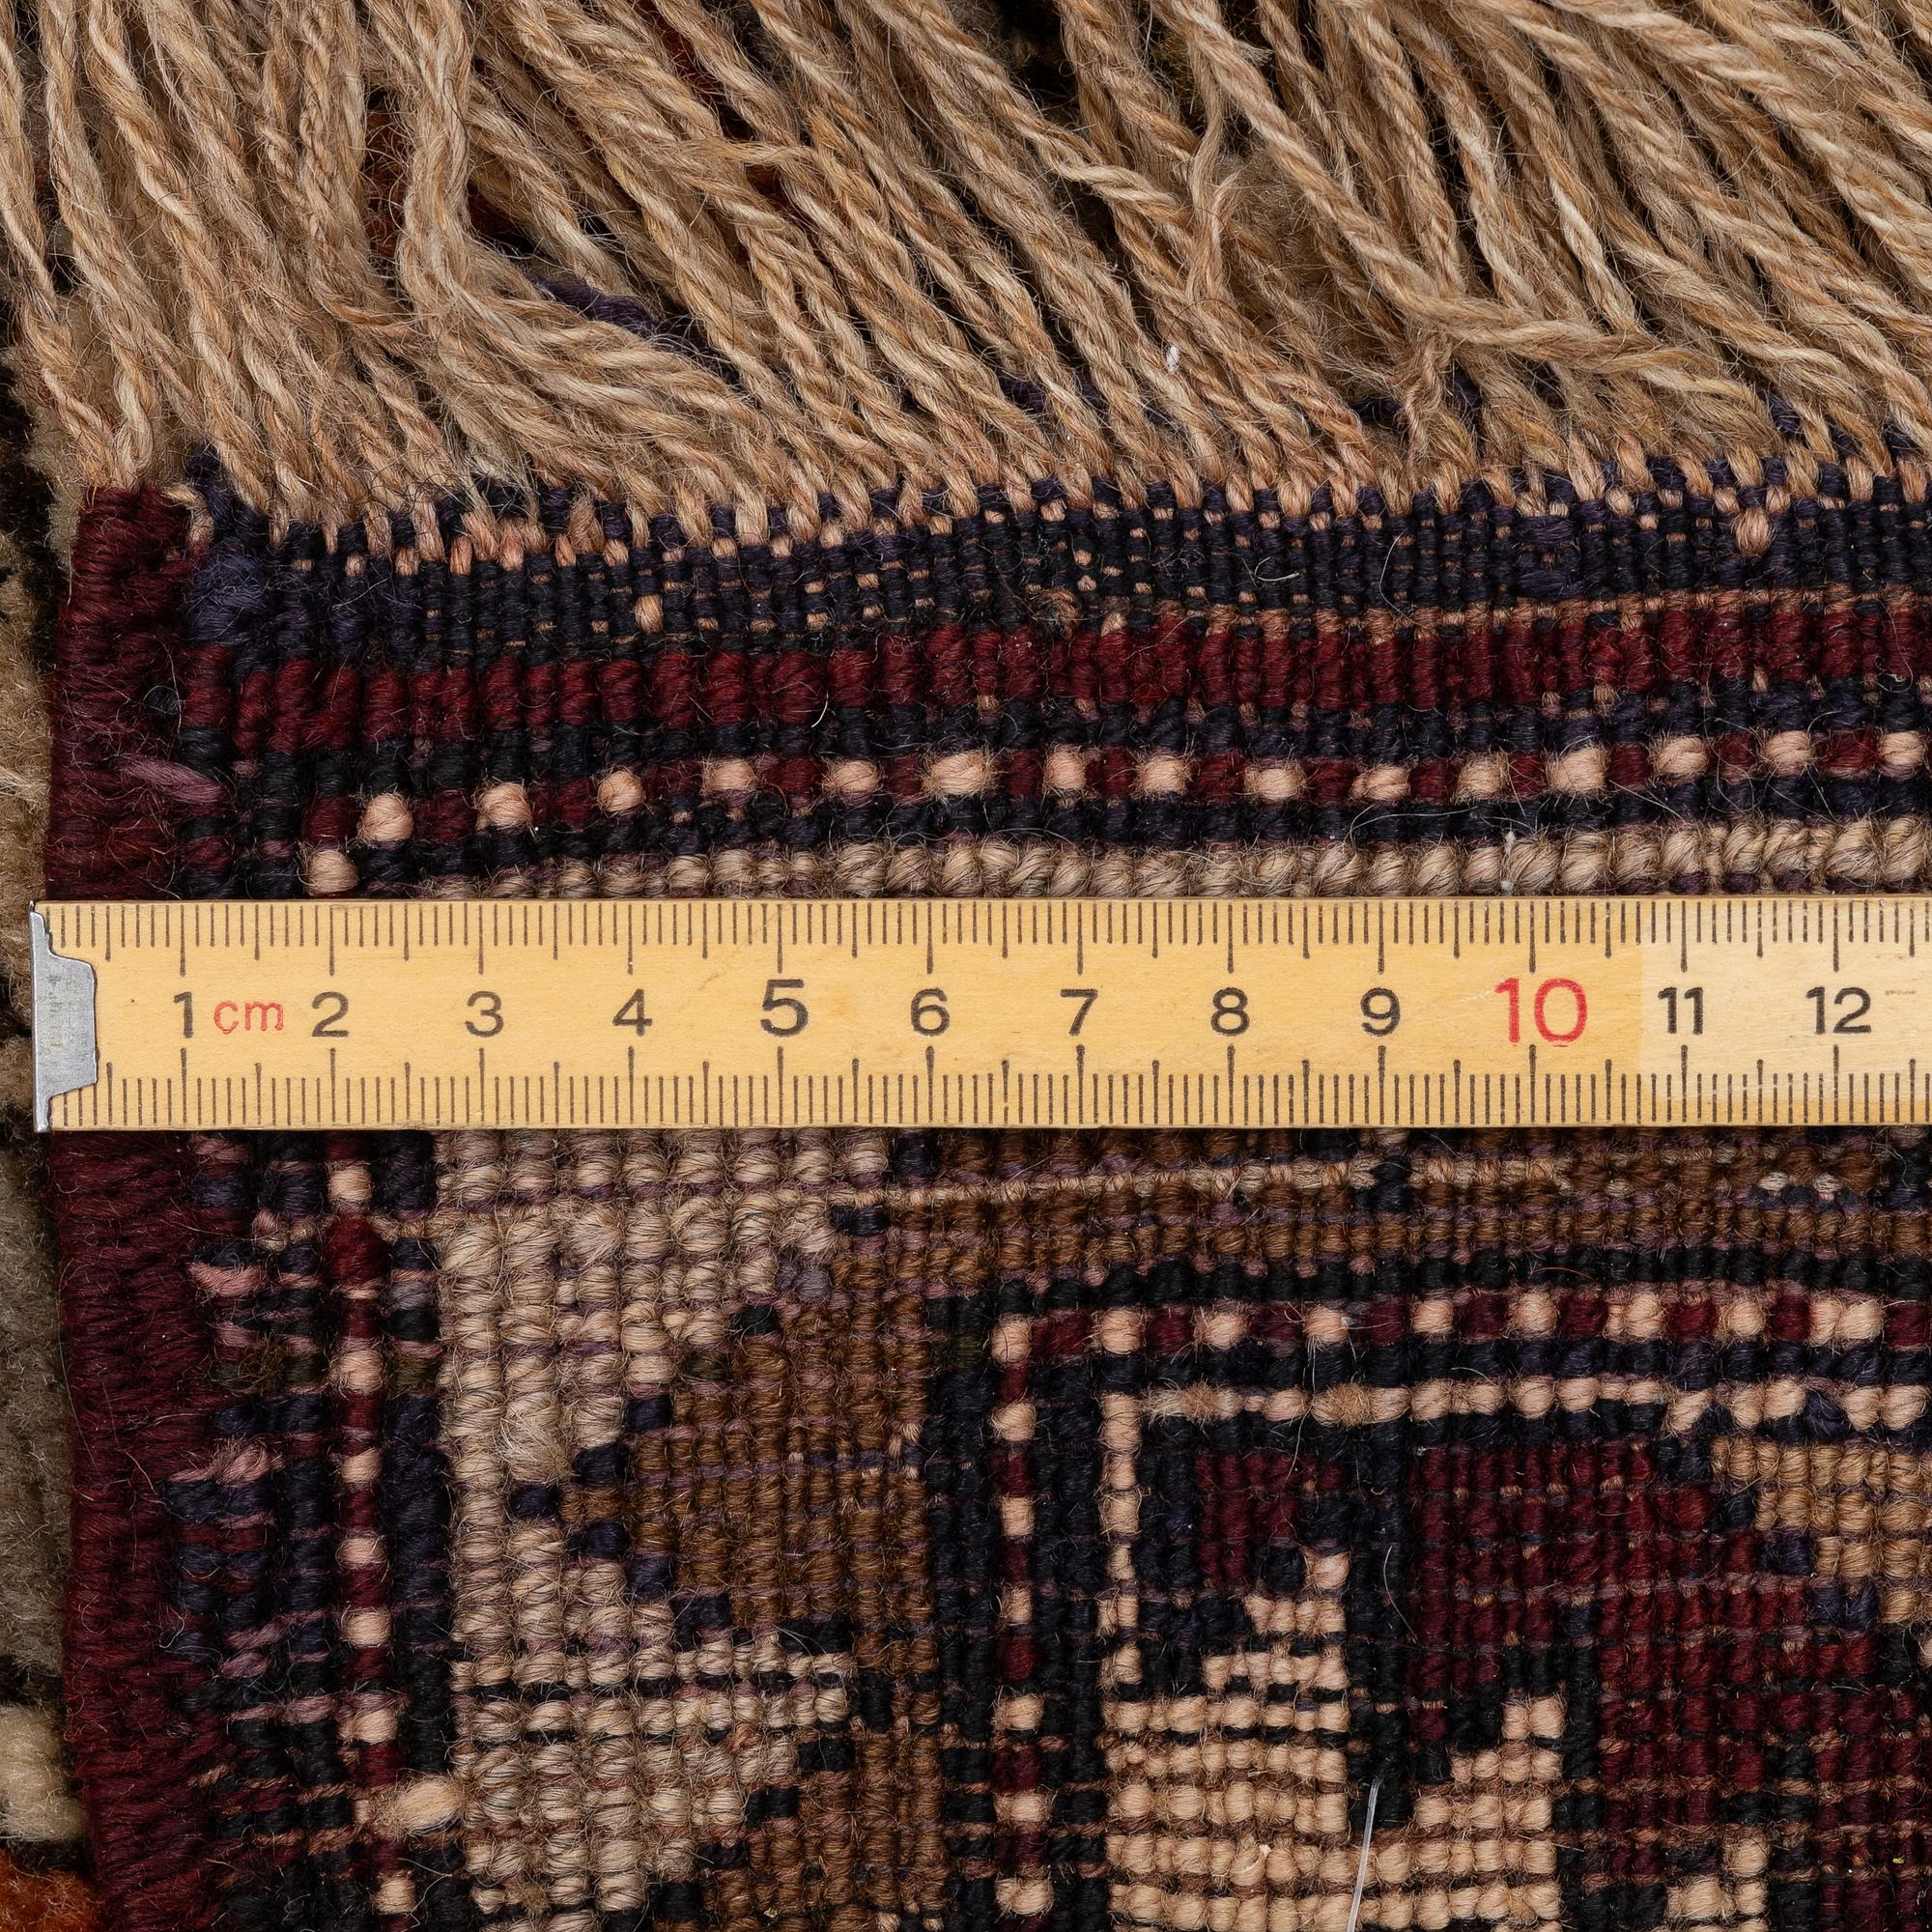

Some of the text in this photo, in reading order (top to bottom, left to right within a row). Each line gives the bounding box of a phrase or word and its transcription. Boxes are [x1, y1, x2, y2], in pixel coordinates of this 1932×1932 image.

[173, 977, 1872, 1045] 1 cm 2 3 4 5 6 7 8 9 10 11 12
